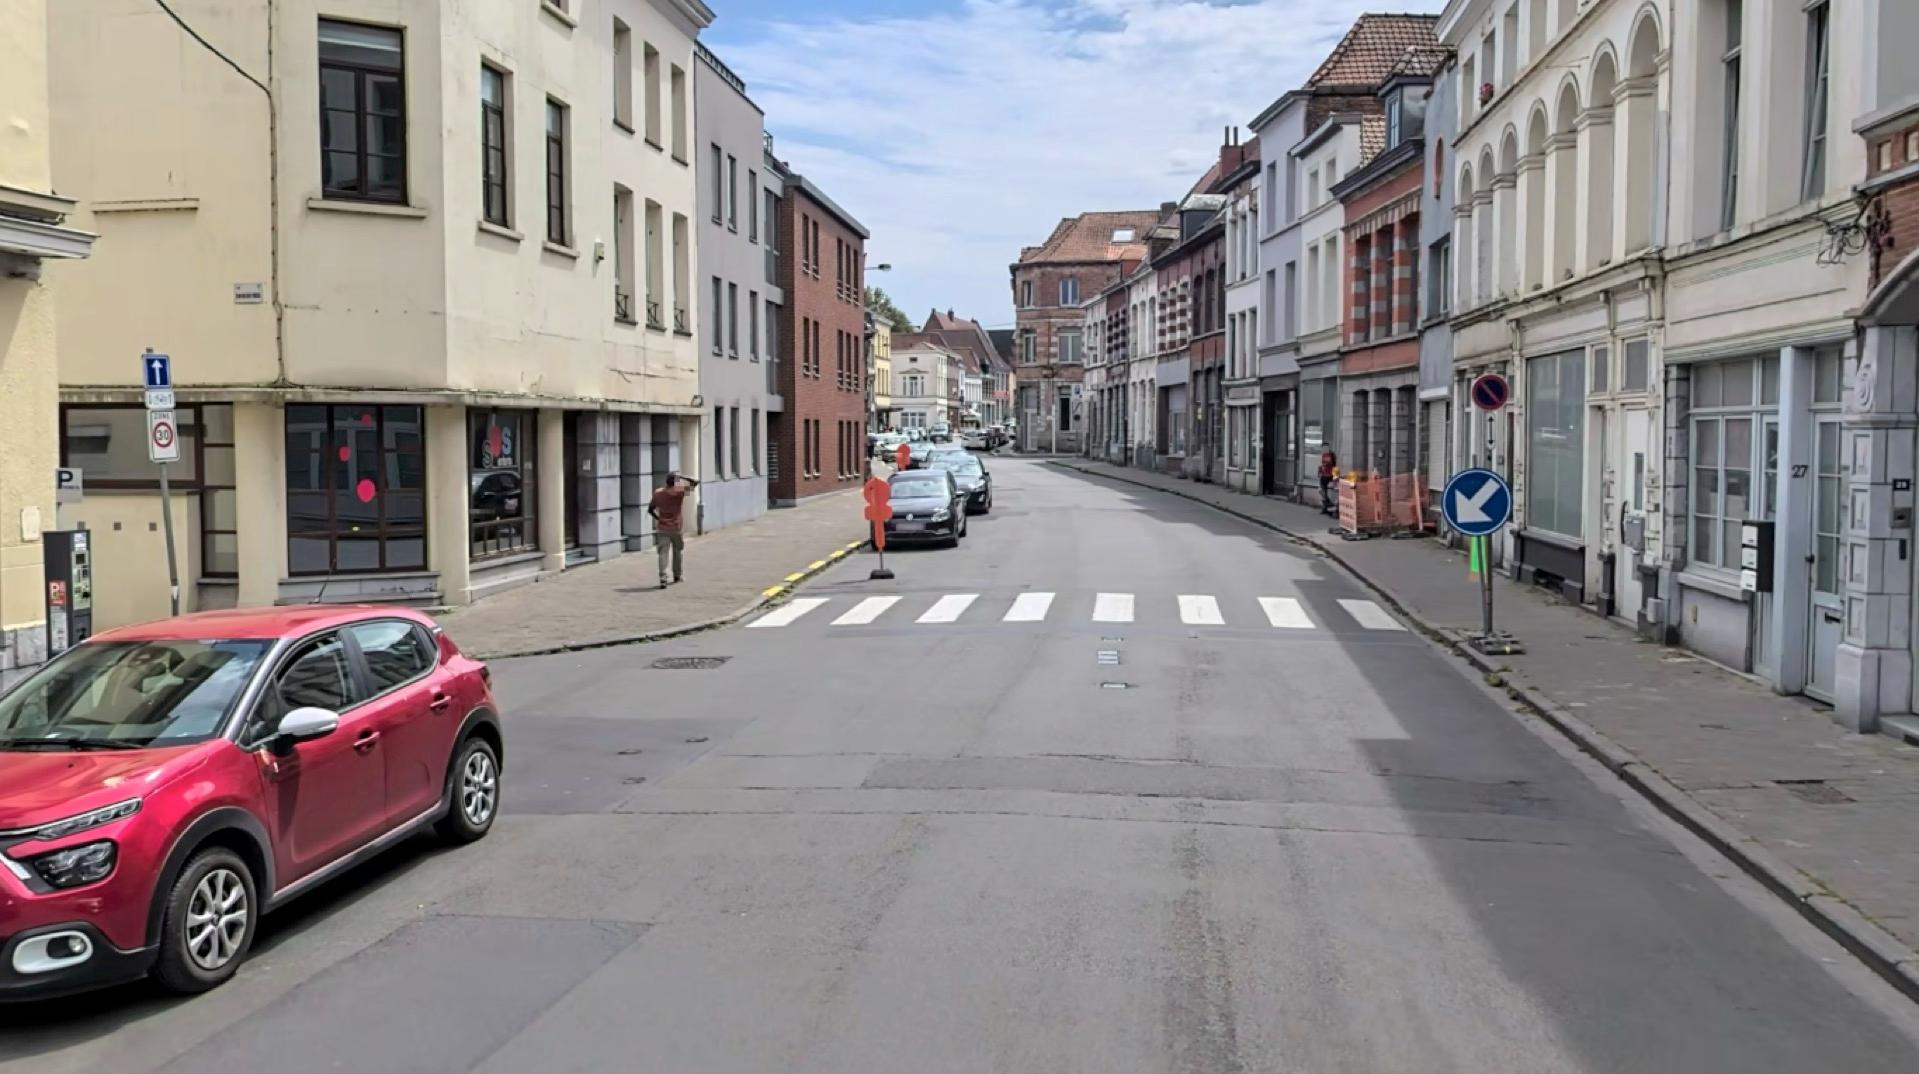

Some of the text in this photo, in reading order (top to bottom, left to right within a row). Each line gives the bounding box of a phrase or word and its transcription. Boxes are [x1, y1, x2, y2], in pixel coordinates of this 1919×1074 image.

[156, 429, 169, 441] 30
[1792, 464, 1808, 479] 27
[58, 470, 73, 489] P
